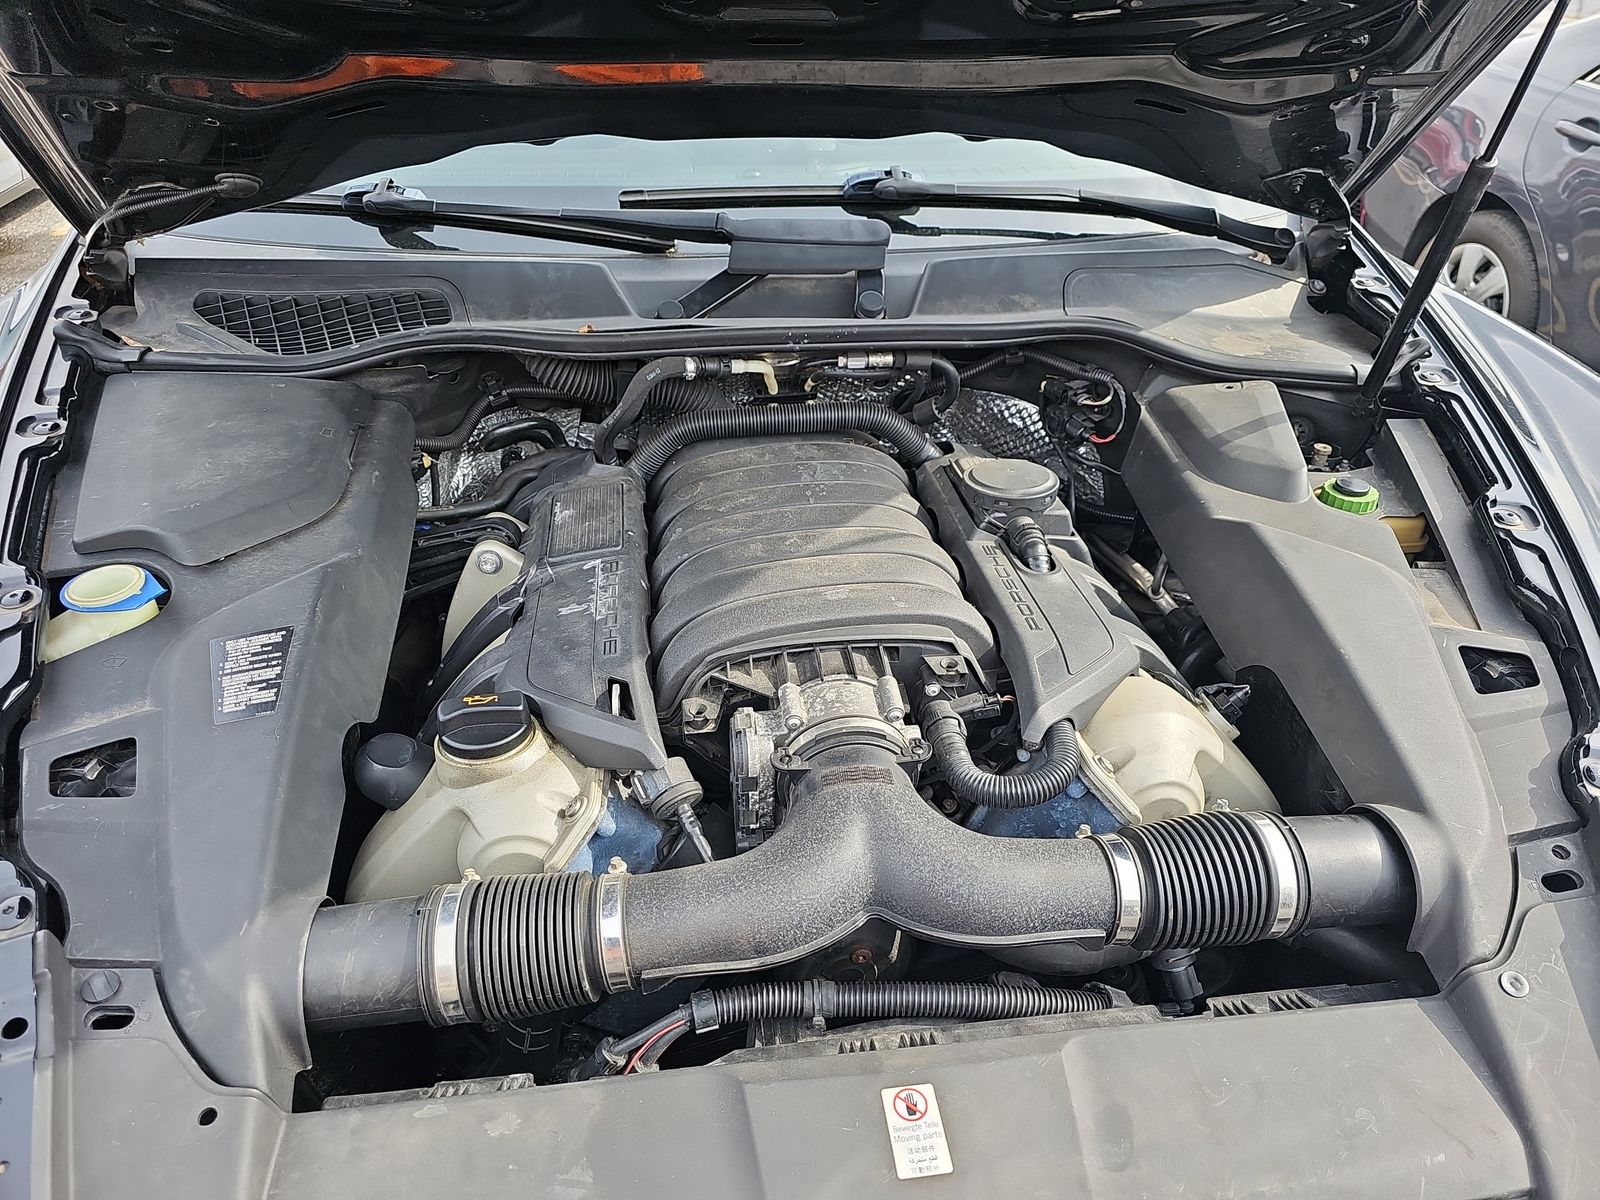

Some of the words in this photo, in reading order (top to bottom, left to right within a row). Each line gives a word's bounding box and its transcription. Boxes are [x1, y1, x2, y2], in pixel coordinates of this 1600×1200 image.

[602, 559, 620, 656] PORSCHE
[981, 543, 1045, 631] PORSCHE
[892, 1123, 922, 1133] Bewegte
[893, 1133, 922, 1143] Moving
[923, 1131, 943, 1141] parts
